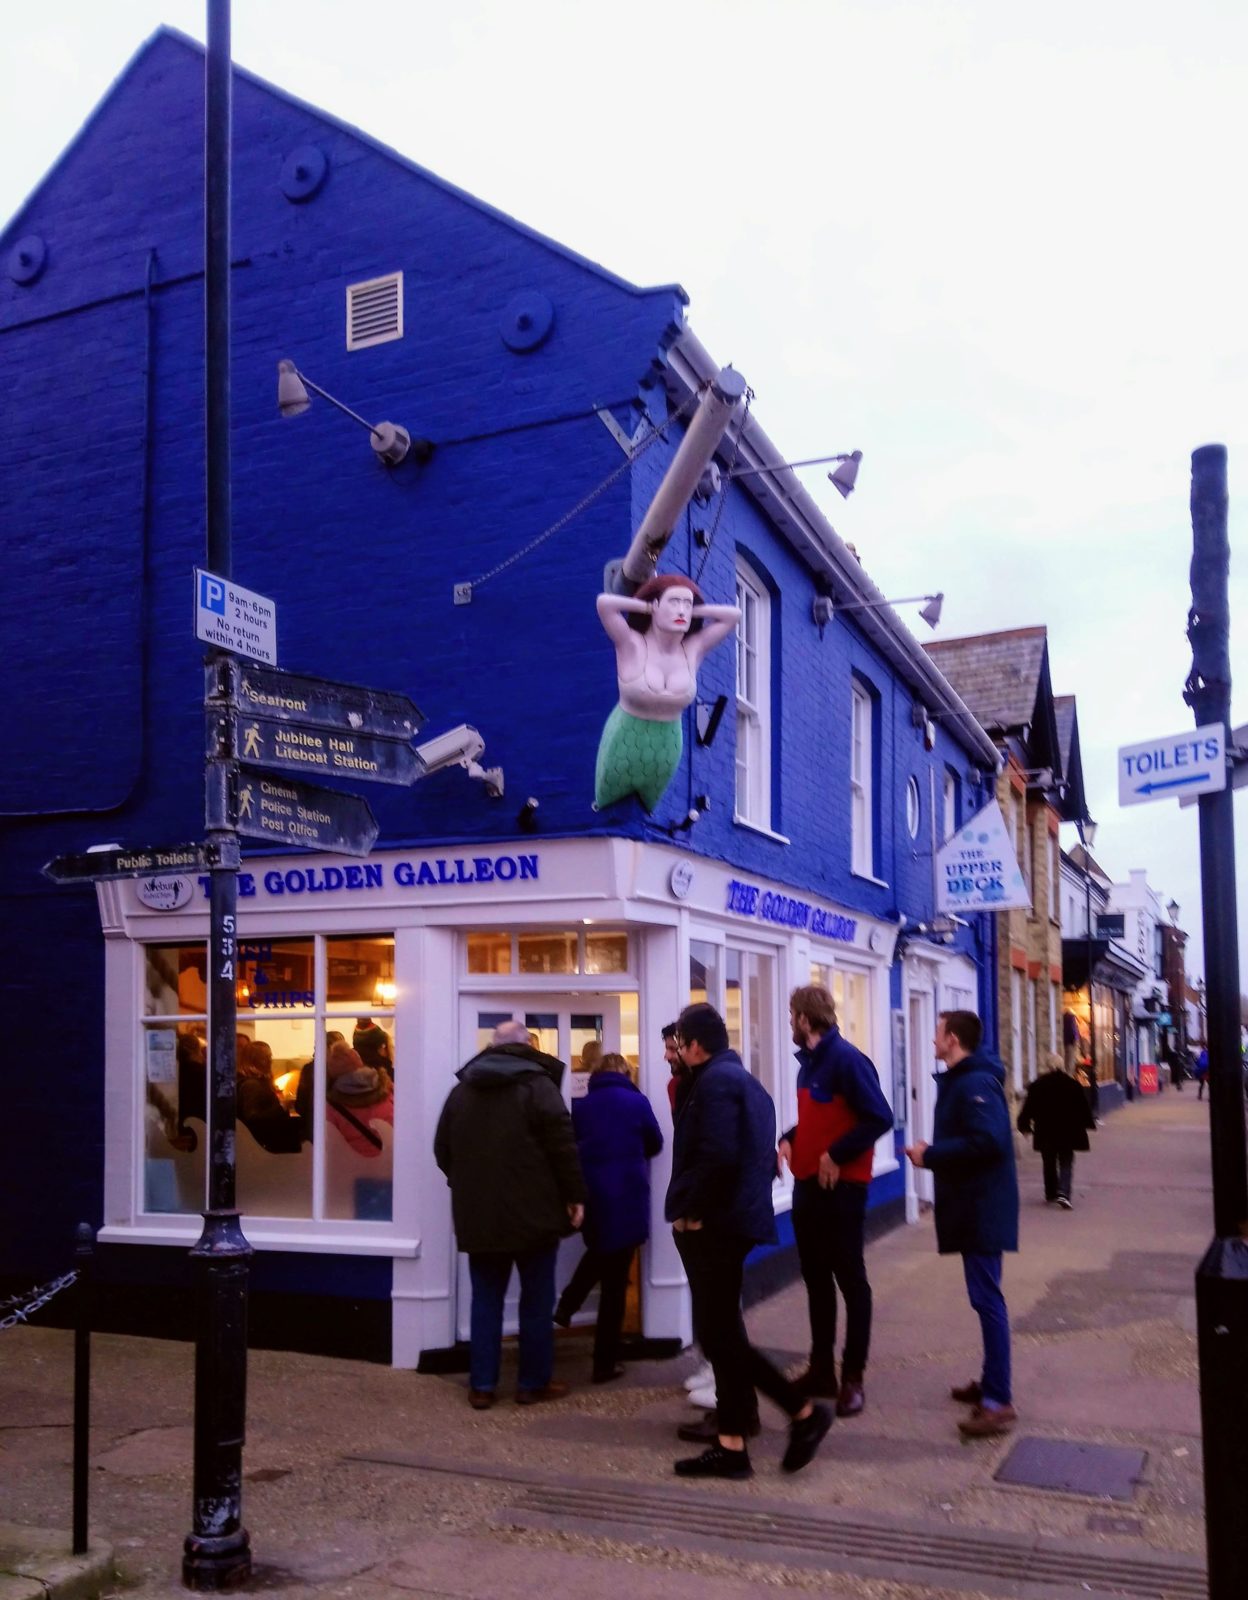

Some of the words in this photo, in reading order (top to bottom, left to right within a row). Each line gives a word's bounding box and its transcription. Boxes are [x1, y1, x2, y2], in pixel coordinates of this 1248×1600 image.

[207, 579, 223, 608] P
[229, 591, 271, 617] 9am-6pm
[217, 617, 230, 631] No
[233, 626, 260, 642] return
[235, 608, 241, 618] 2
[244, 612, 268, 629] hours
[205, 628, 234, 646] within
[237, 640, 243, 649] 4
[246, 642, 270, 659] hours
[250, 691, 306, 711] Seafront
[275, 730, 322, 748] Jubilee
[329, 738, 353, 753] Hall
[275, 745, 328, 764] Lifeboat
[333, 754, 378, 771] Station
[1123, 737, 1219, 777] TOILETS
[260, 781, 297, 800] Cinema
[261, 799, 292, 816] Police
[297, 806, 331, 824] Station
[261, 816, 284, 831] Post
[289, 822, 318, 837] Office
[117, 854, 151, 870] Public
[156, 852, 194, 866] Toilets
[959, 850, 983, 859] THE
[198, 873, 256, 898] TE
[264, 864, 382, 894] GOLDEN
[394, 855, 538, 886] GALLEON
[945, 861, 1003, 877] UPPER
[946, 876, 1004, 893] DECK
[728, 880, 759, 915] THE
[248, 992, 315, 1009] CHIPS
